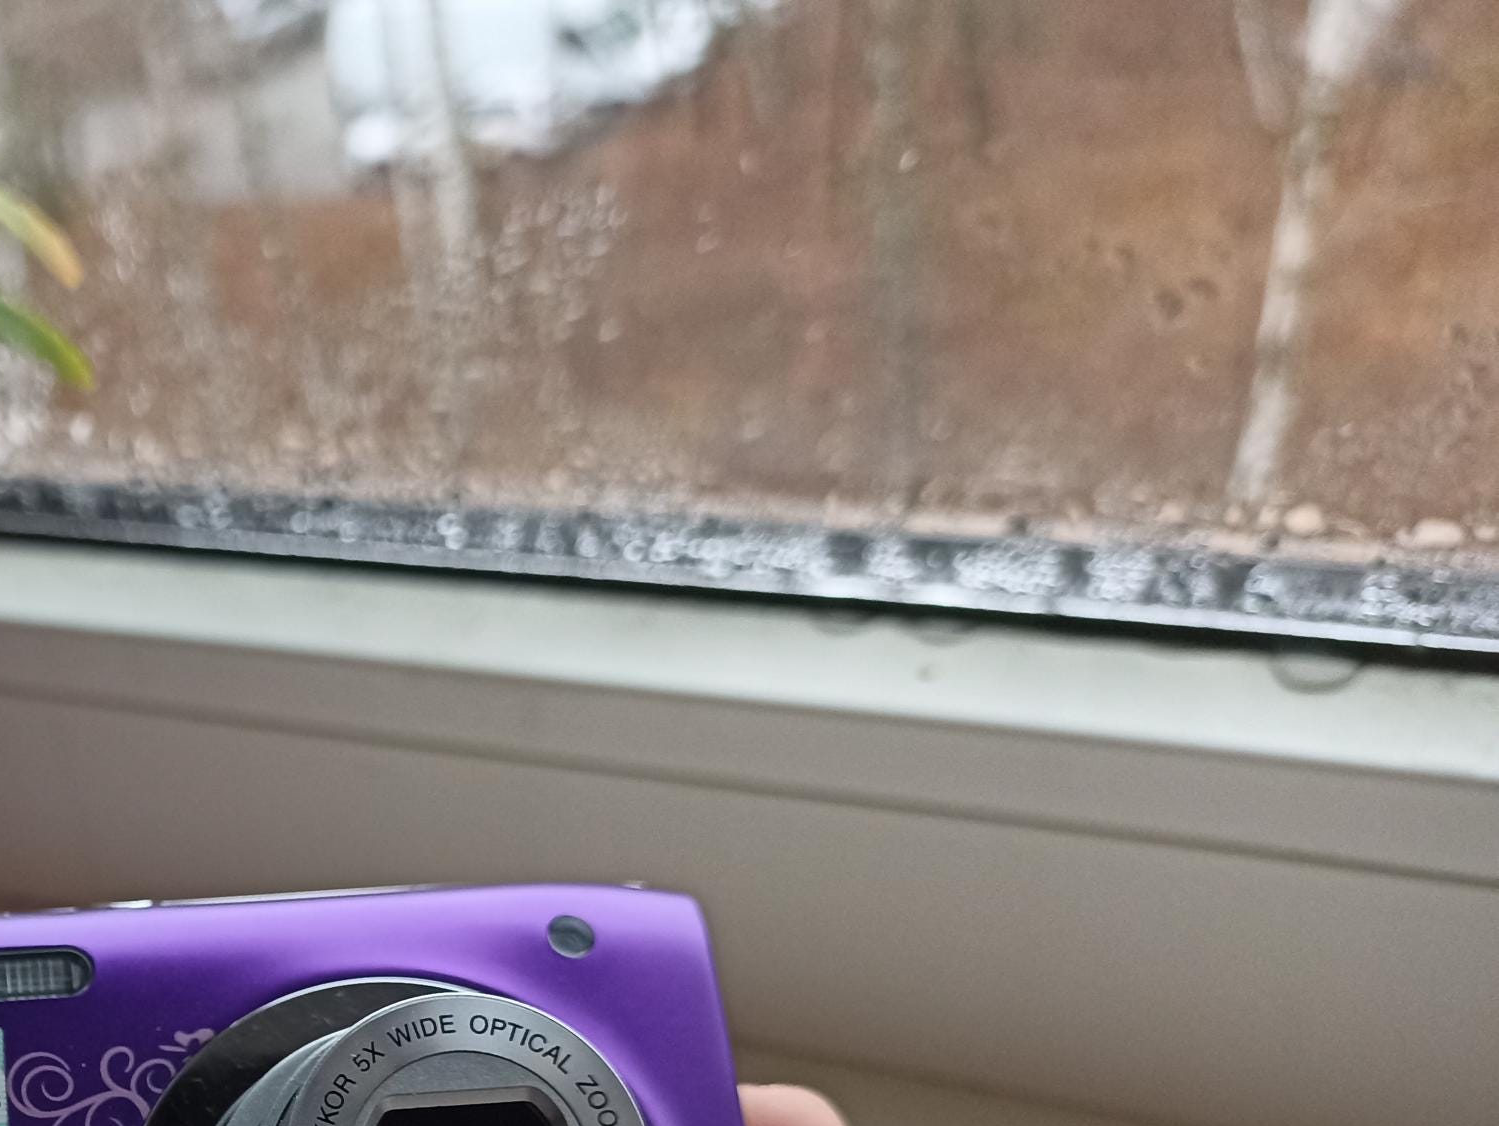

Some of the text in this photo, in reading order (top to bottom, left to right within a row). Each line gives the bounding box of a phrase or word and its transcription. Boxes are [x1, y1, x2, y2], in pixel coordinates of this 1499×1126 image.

[353, 1041, 385, 1073] 5X
[386, 1014, 457, 1048] WIDE
[469, 1014, 573, 1074] OPTICAL
